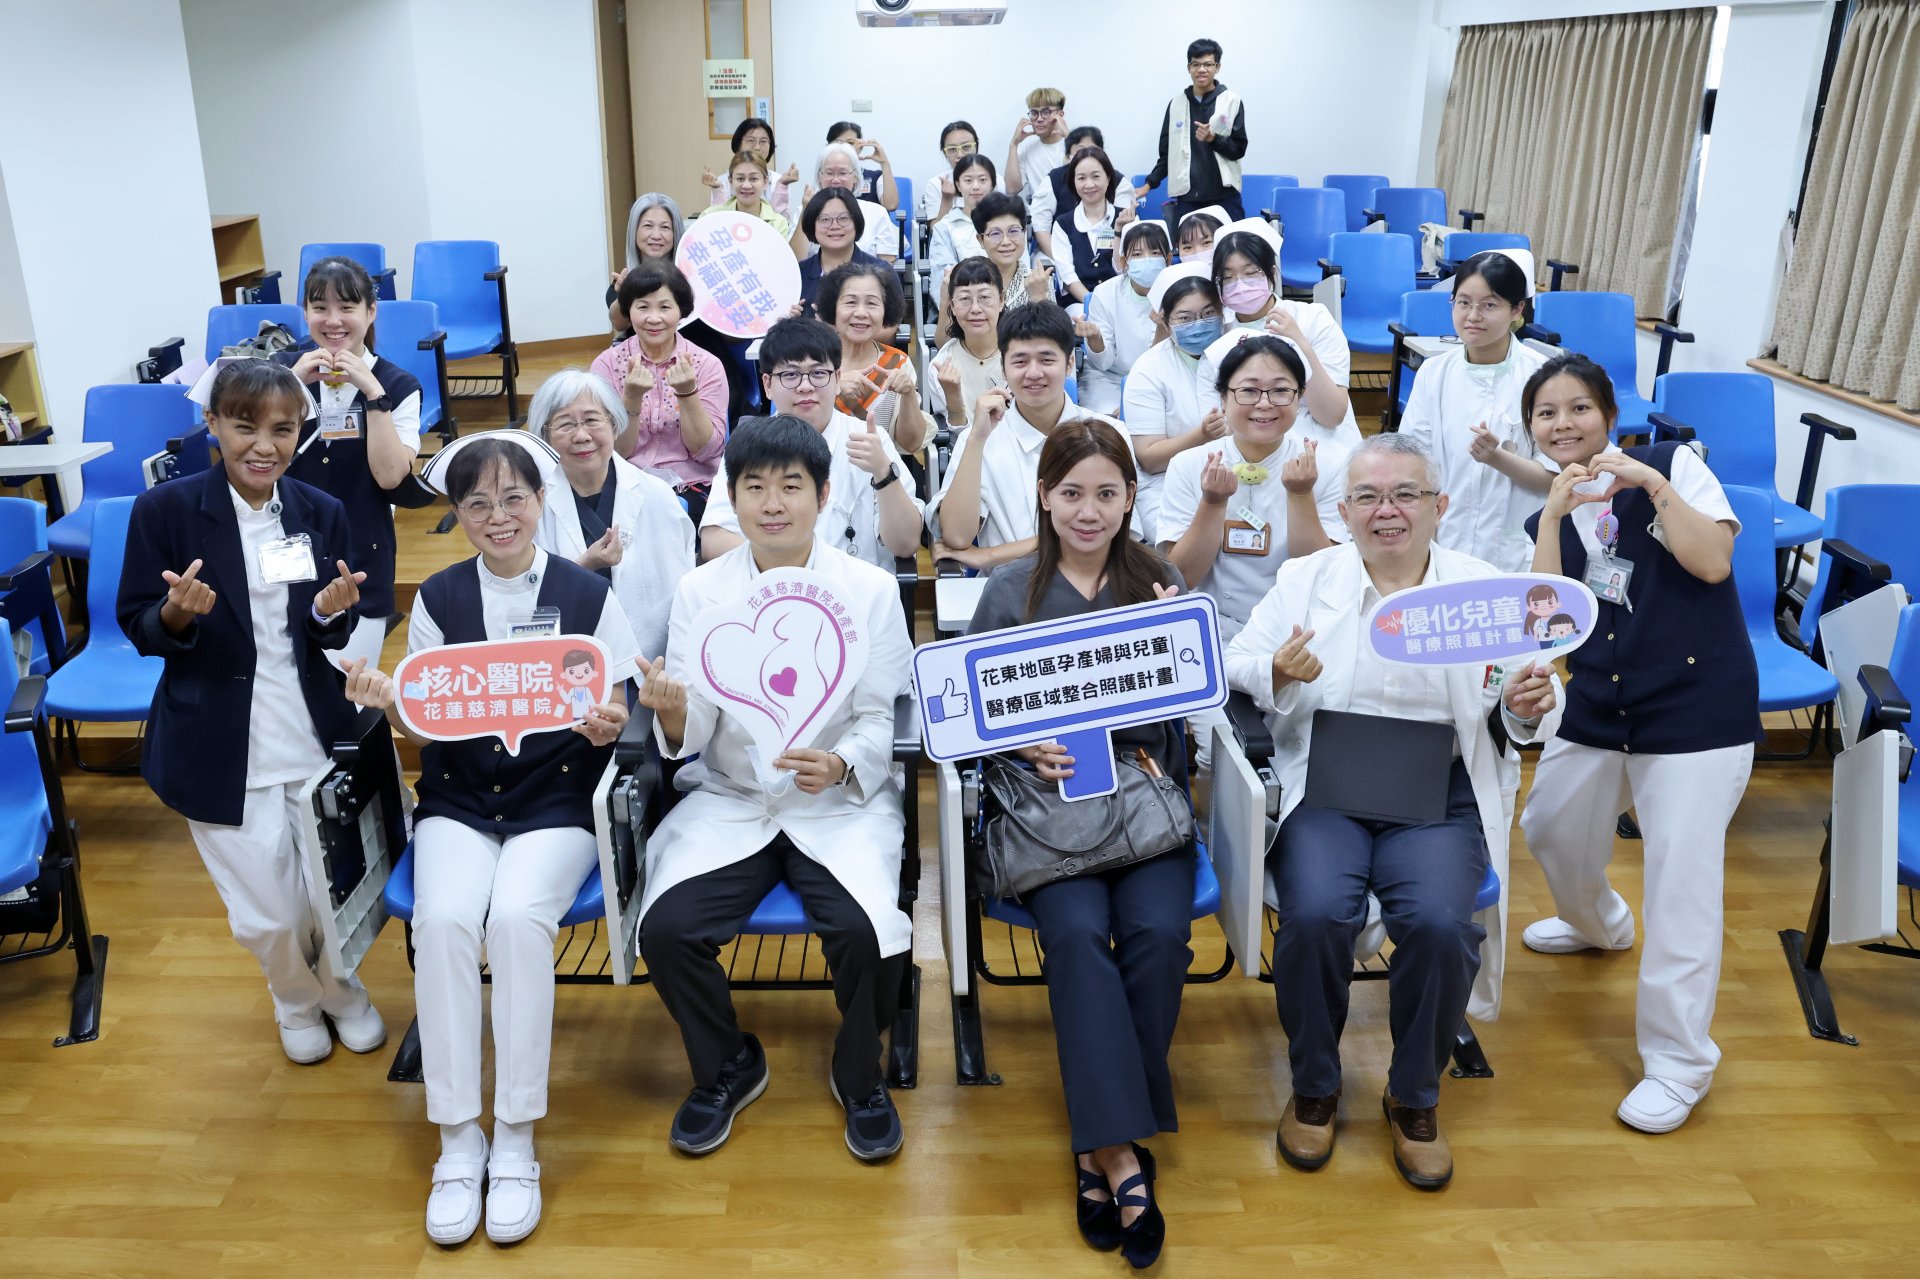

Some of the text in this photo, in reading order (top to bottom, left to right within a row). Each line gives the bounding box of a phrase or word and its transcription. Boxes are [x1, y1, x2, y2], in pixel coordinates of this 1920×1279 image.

[709, 226, 778, 317] 孕產有我
[747, 581, 858, 644] 花蓮慈濟醫院婦產部
[1400, 596, 1523, 638] 優化兒童
[980, 636, 1170, 688] 花東地區孕產婦與兒童
[1405, 627, 1524, 655] 醫療照護計畫
[418, 660, 554, 699] 核心醫院
[986, 667, 1175, 718] 醫療區域整合照護計畫
[423, 697, 552, 721] 花蓮慈濟醫院
